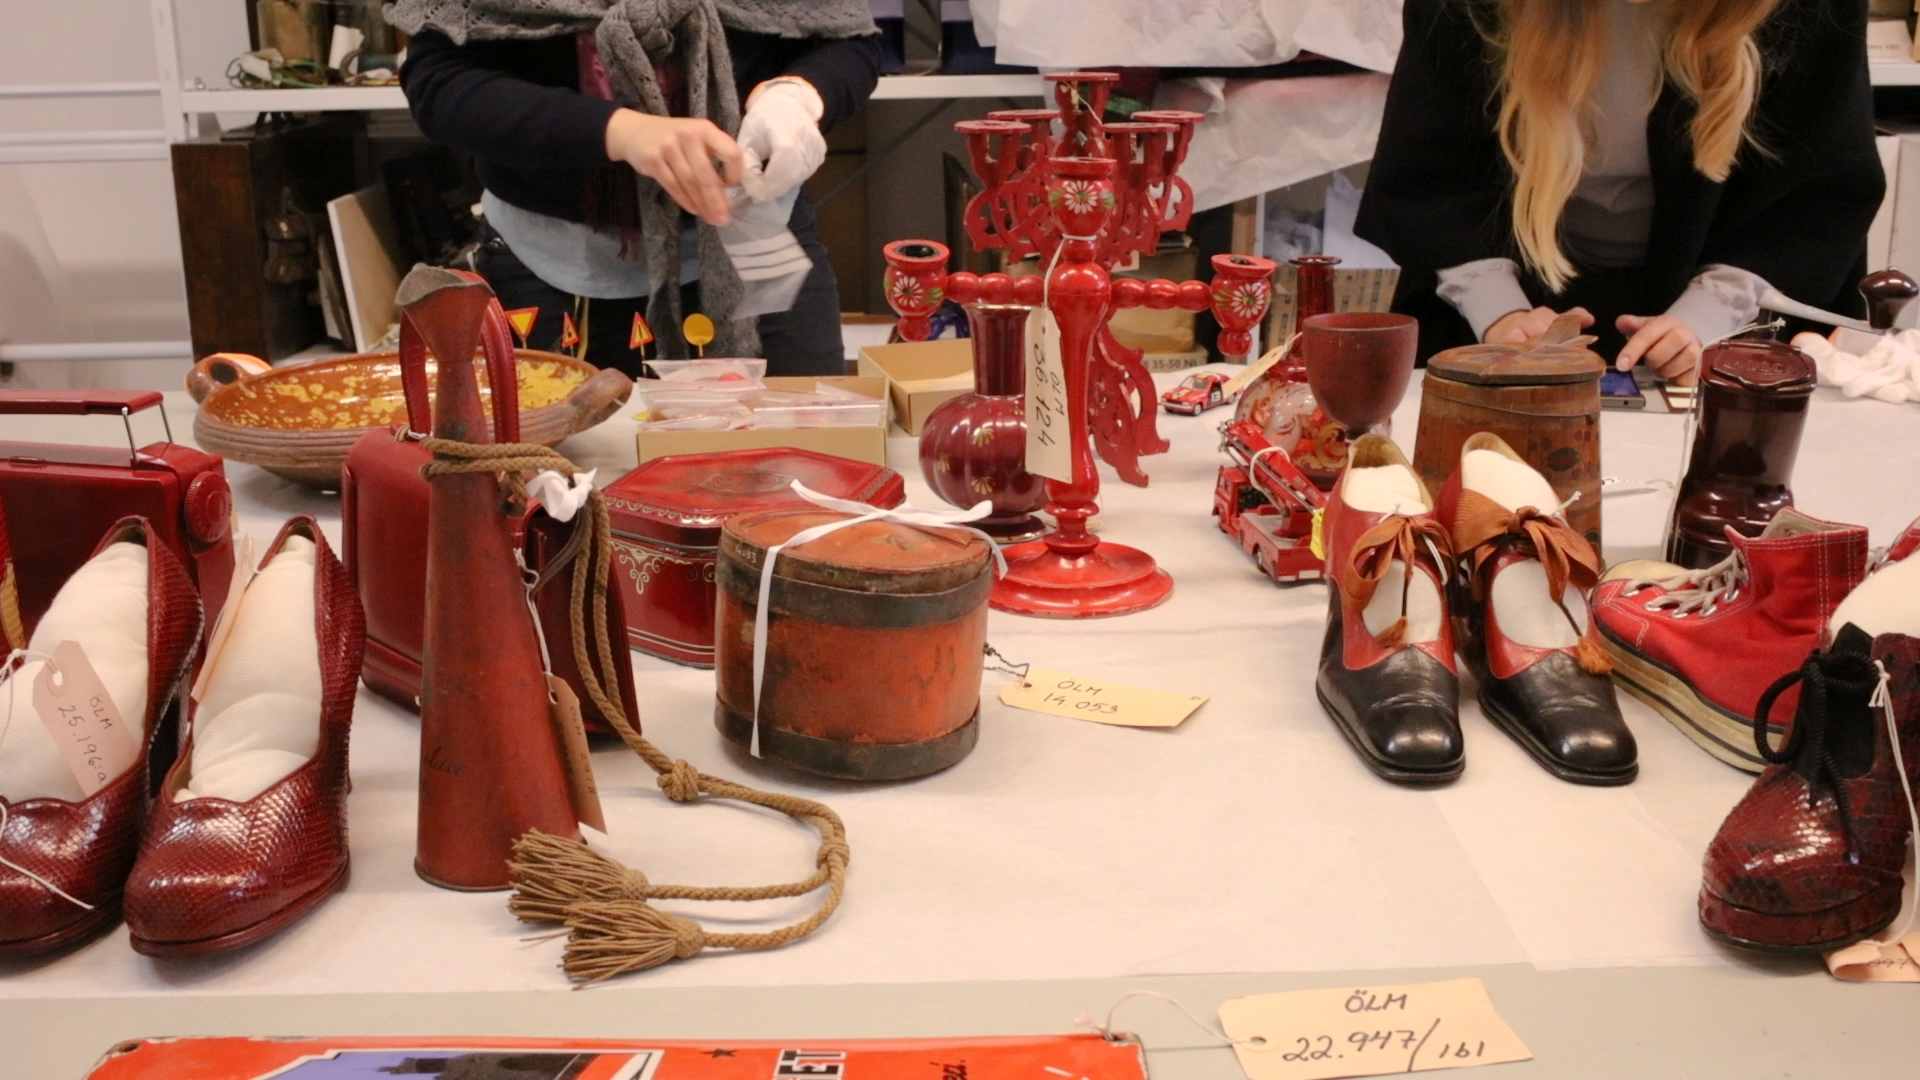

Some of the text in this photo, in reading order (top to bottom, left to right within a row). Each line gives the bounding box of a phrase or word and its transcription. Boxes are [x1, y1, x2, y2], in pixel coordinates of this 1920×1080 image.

[1033, 343, 1056, 447] 36.124
[1050, 371, 1066, 417] ÖLM
[1057, 678, 1103, 696] ÖLM
[89, 694, 114, 730] ÖLM
[1043, 693, 1119, 714] 14.053
[1344, 988, 1409, 1013] ÖLM
